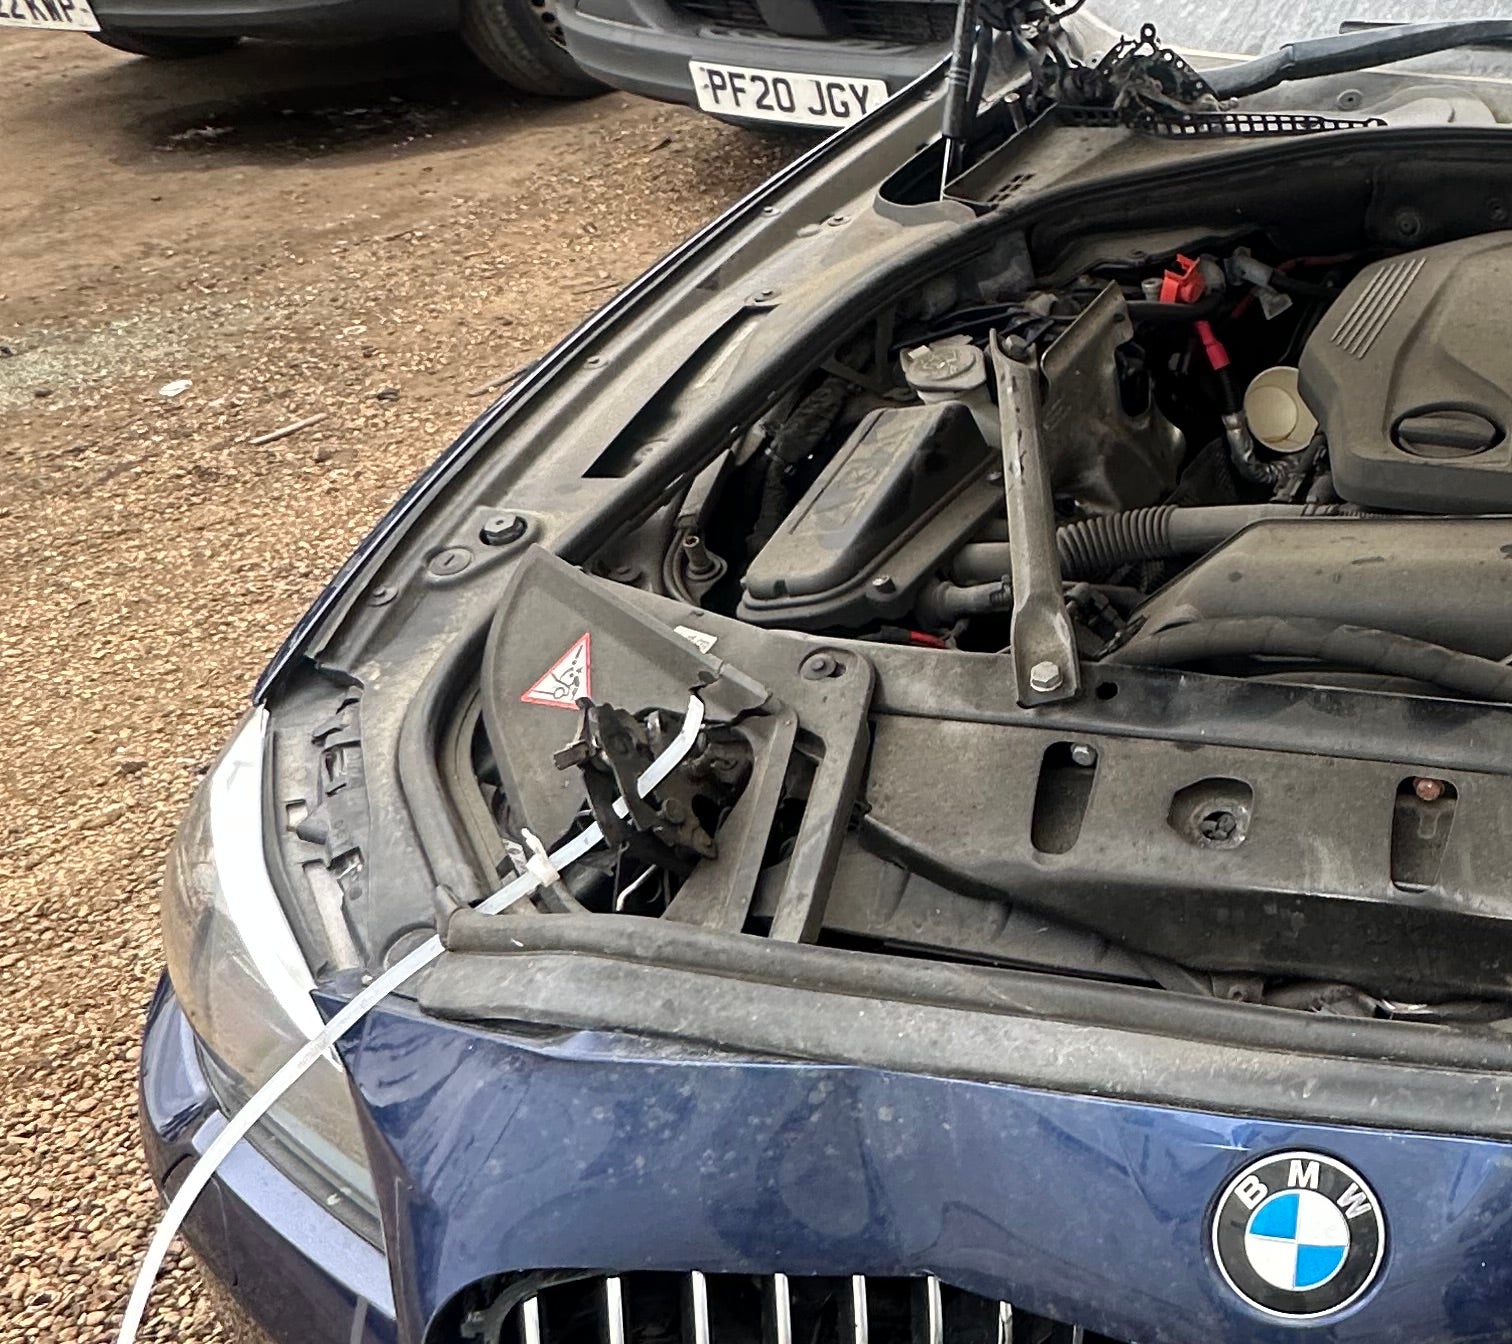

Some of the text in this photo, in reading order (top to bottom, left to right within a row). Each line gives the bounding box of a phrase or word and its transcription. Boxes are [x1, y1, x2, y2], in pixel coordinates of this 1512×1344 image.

[706, 68, 869, 119] PF20 JGY
[1233, 1159, 1373, 1220] BMW
